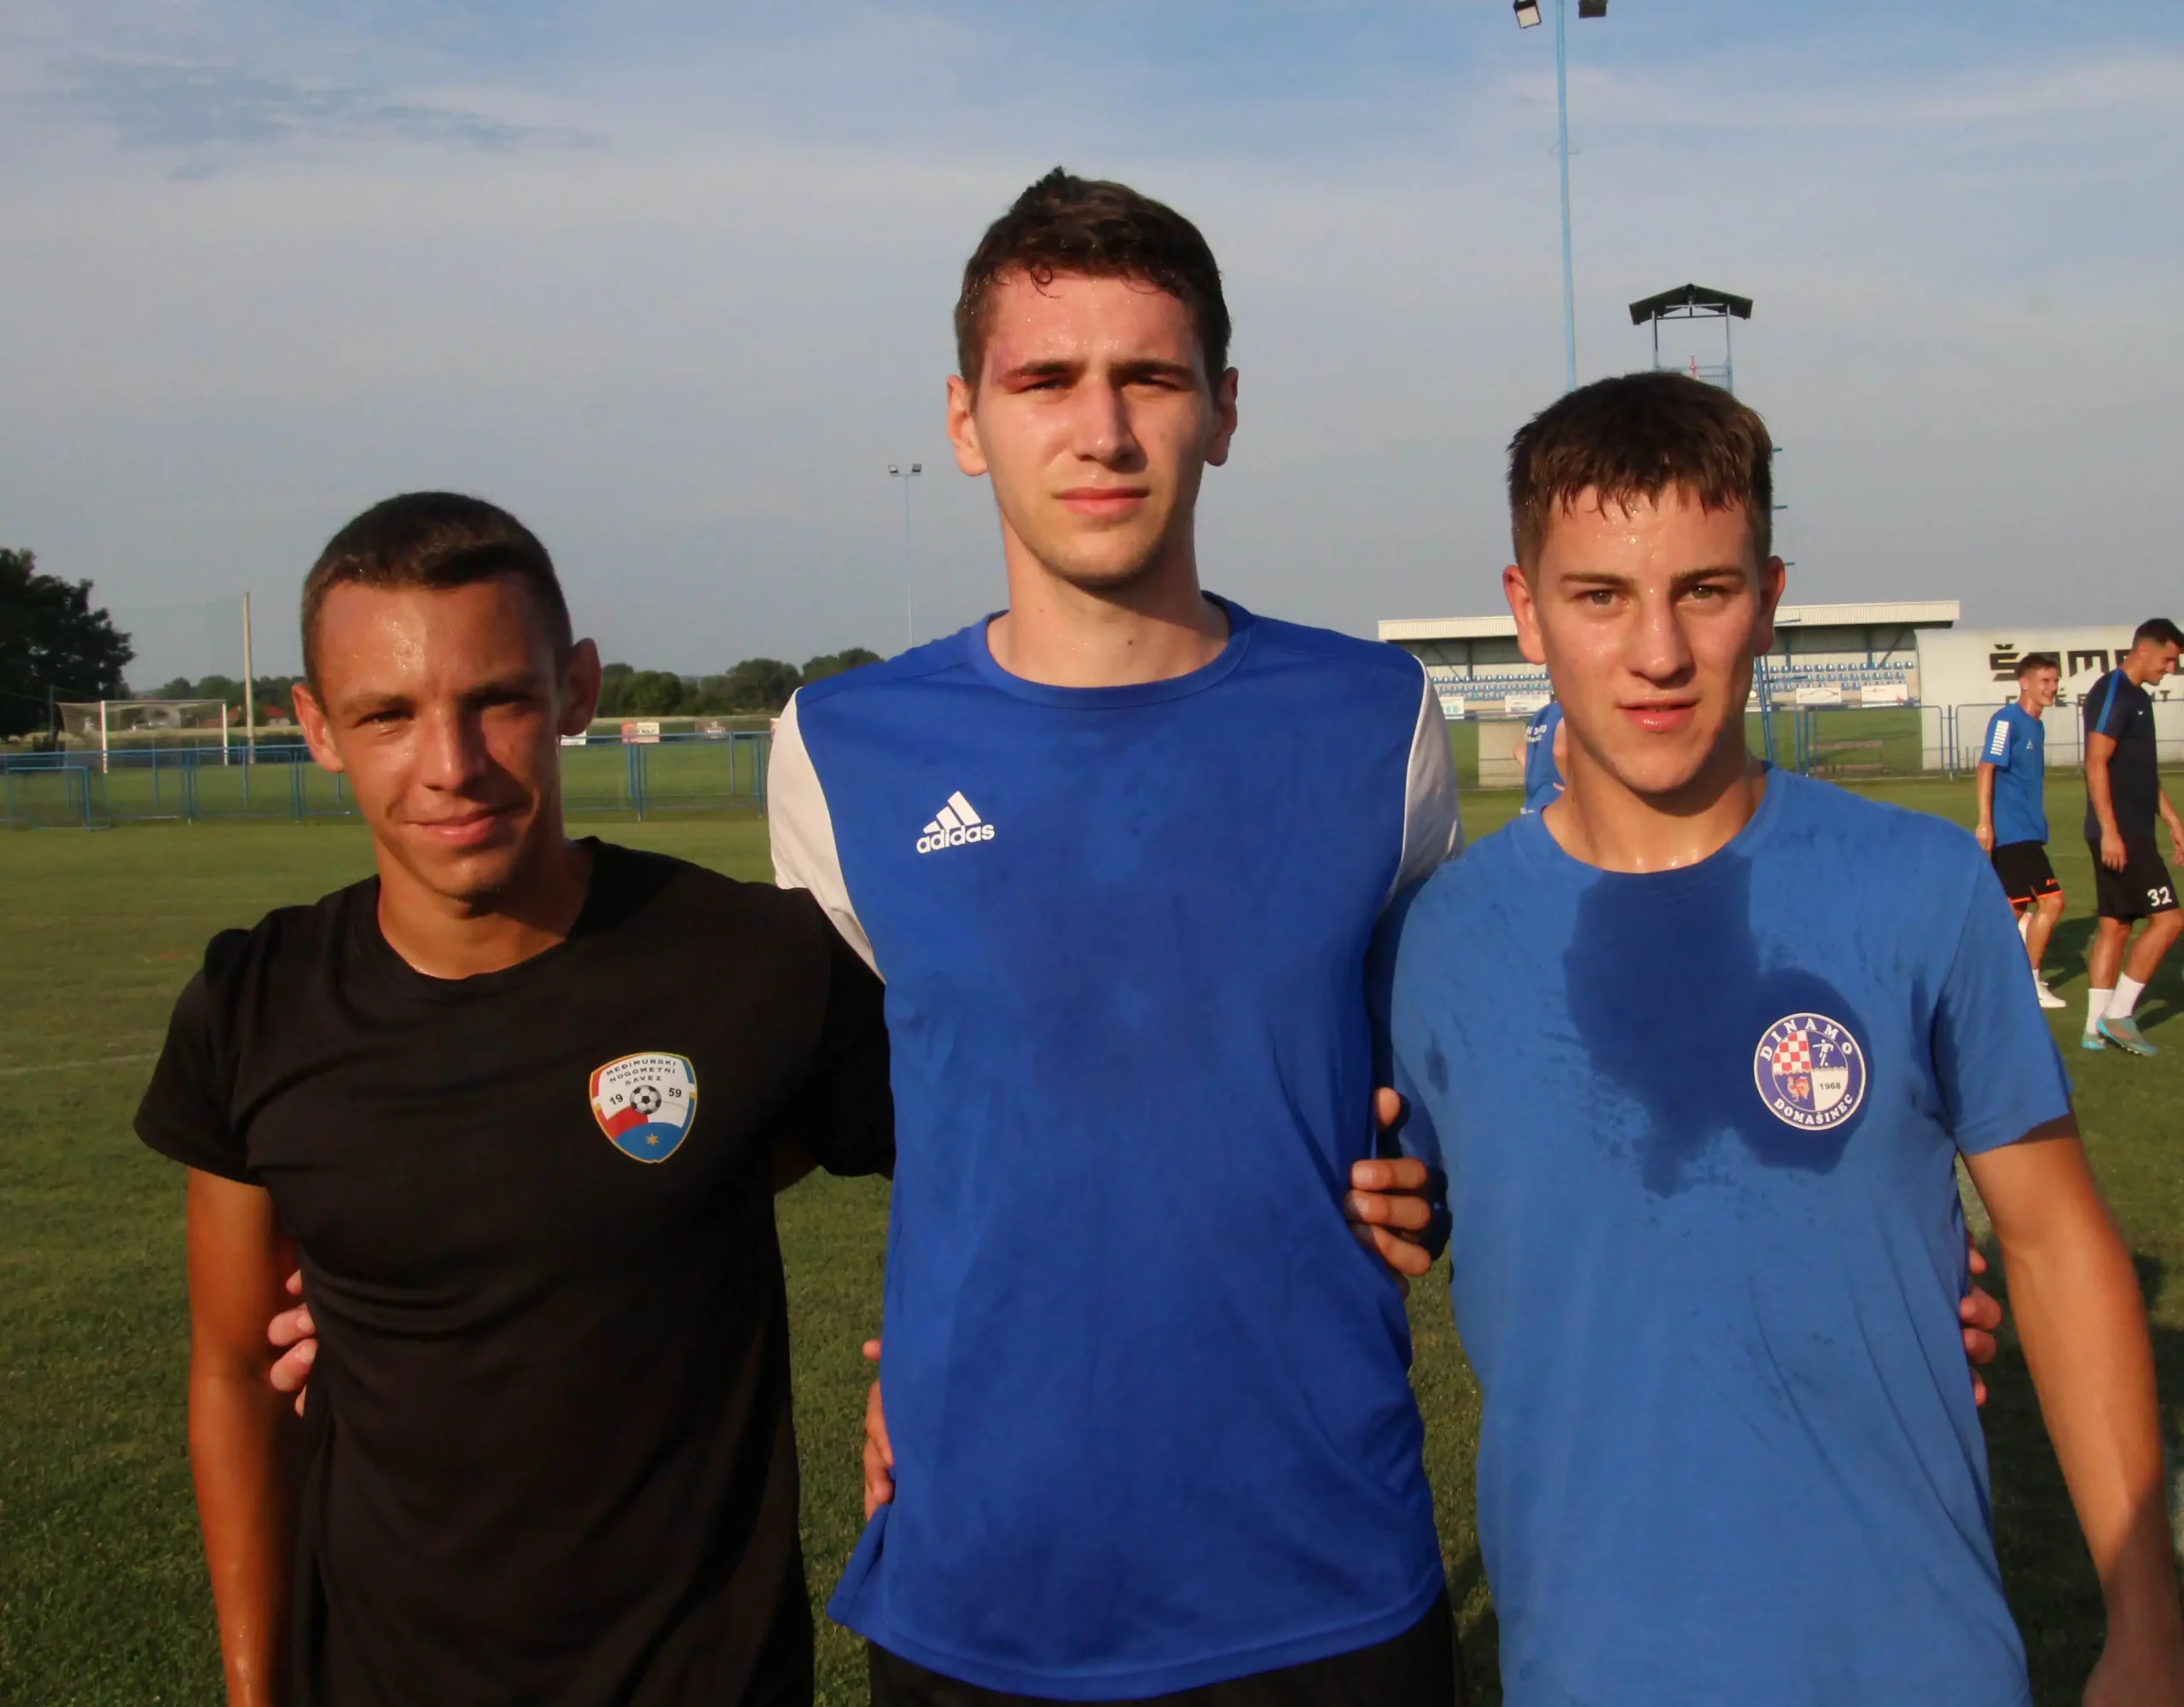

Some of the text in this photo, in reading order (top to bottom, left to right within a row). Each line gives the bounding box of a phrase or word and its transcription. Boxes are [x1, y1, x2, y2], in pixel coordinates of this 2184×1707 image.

[915, 824, 996, 854] adidas
[2146, 885, 2173, 907] 32
[1759, 1018, 1853, 1061] DINAMO
[609, 1067, 676, 1083] NOGOMETNI
[624, 1076, 662, 1086] SAVEZ
[609, 1087, 682, 1105] 19 59
[1774, 1094, 1853, 1124] DOMAŠINEC
